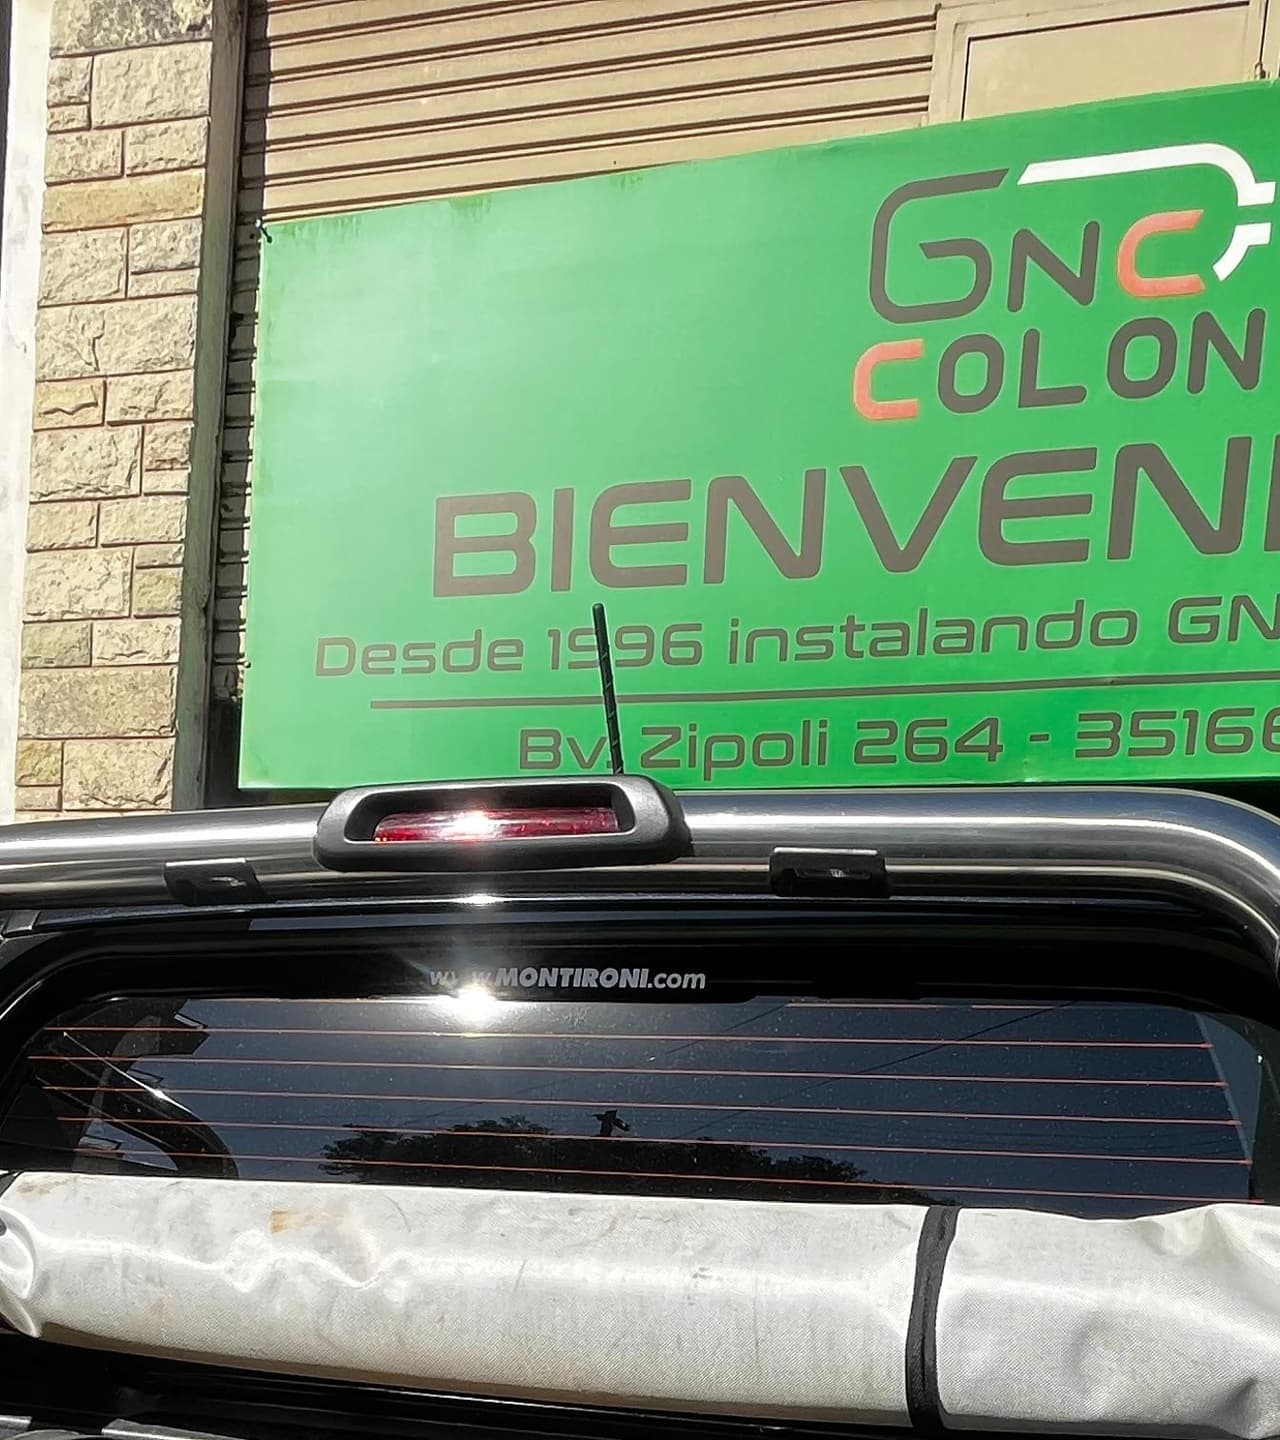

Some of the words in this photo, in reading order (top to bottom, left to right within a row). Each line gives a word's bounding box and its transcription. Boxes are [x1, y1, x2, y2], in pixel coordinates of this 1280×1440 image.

[869, 167, 1207, 324] GNC
[851, 308, 1266, 421] COLON
[317, 629, 525, 677] Desde
[728, 598, 1138, 664] instalando
[639, 717, 829, 781] Zipoli
[852, 717, 1001, 765] 264
